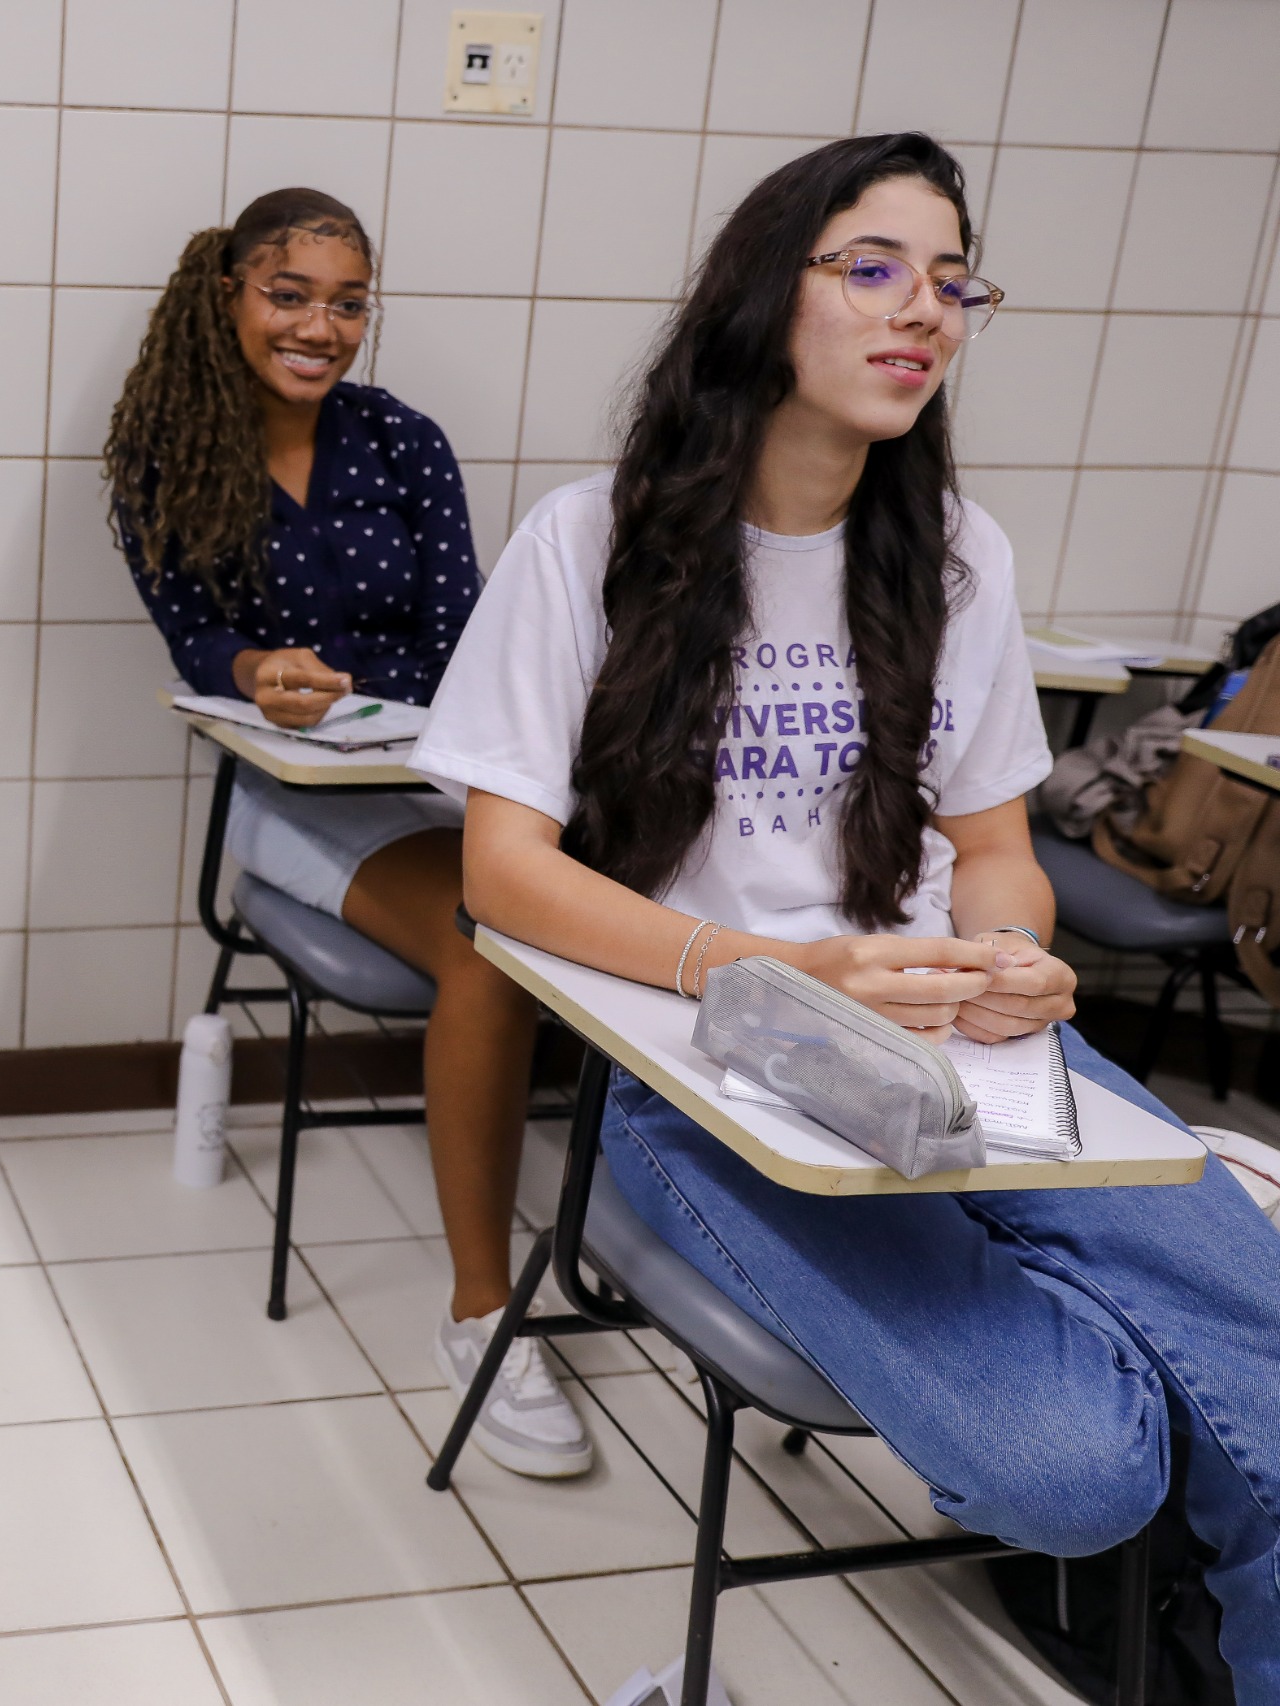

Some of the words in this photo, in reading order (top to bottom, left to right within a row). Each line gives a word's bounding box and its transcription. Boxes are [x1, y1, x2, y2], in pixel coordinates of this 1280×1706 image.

[729, 643, 858, 669] ROGR
[716, 699, 955, 739] IVERSIDE
[713, 745, 799, 783] ARA
[739, 807, 821, 837] BAH
